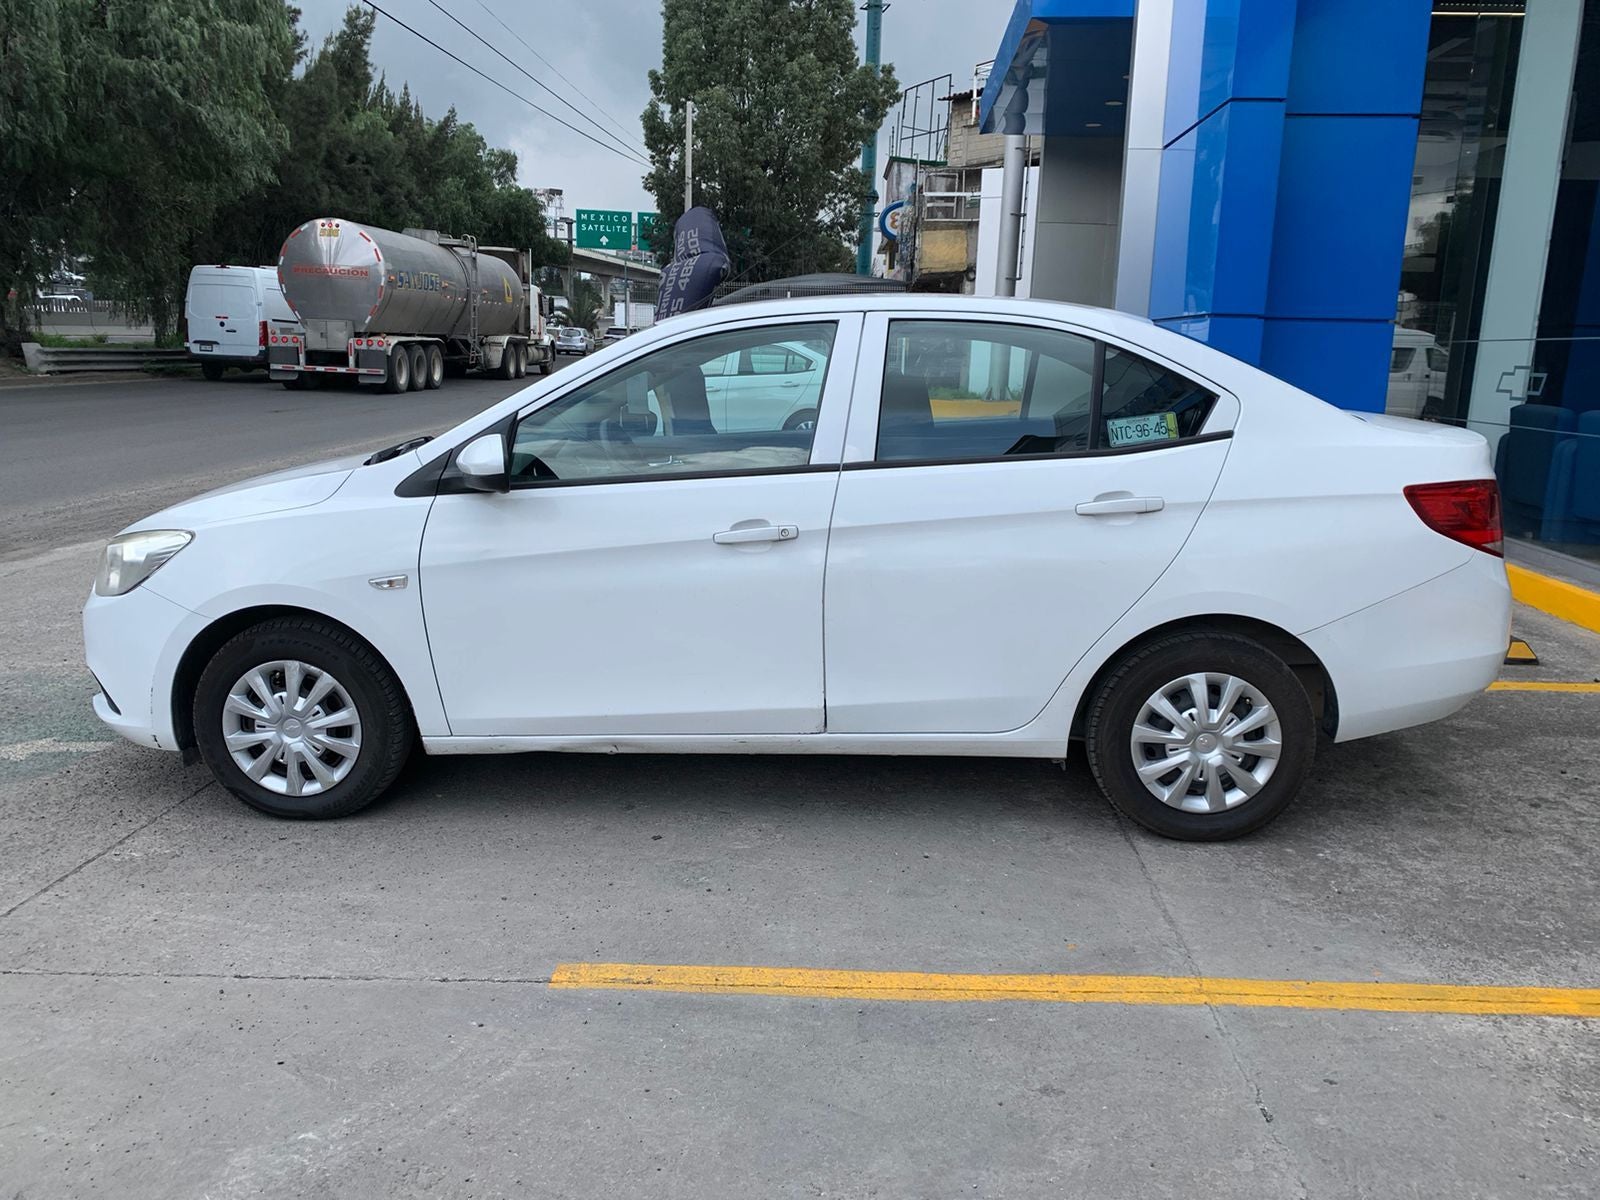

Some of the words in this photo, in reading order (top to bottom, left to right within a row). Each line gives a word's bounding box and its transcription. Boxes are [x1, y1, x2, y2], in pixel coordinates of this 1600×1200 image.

[581, 213, 628, 223] MEXICO
[581, 223, 628, 233] SATELITE
[292, 265, 369, 277] PRECAUCION
[1110, 421, 1168, 441] NTC-96-45
